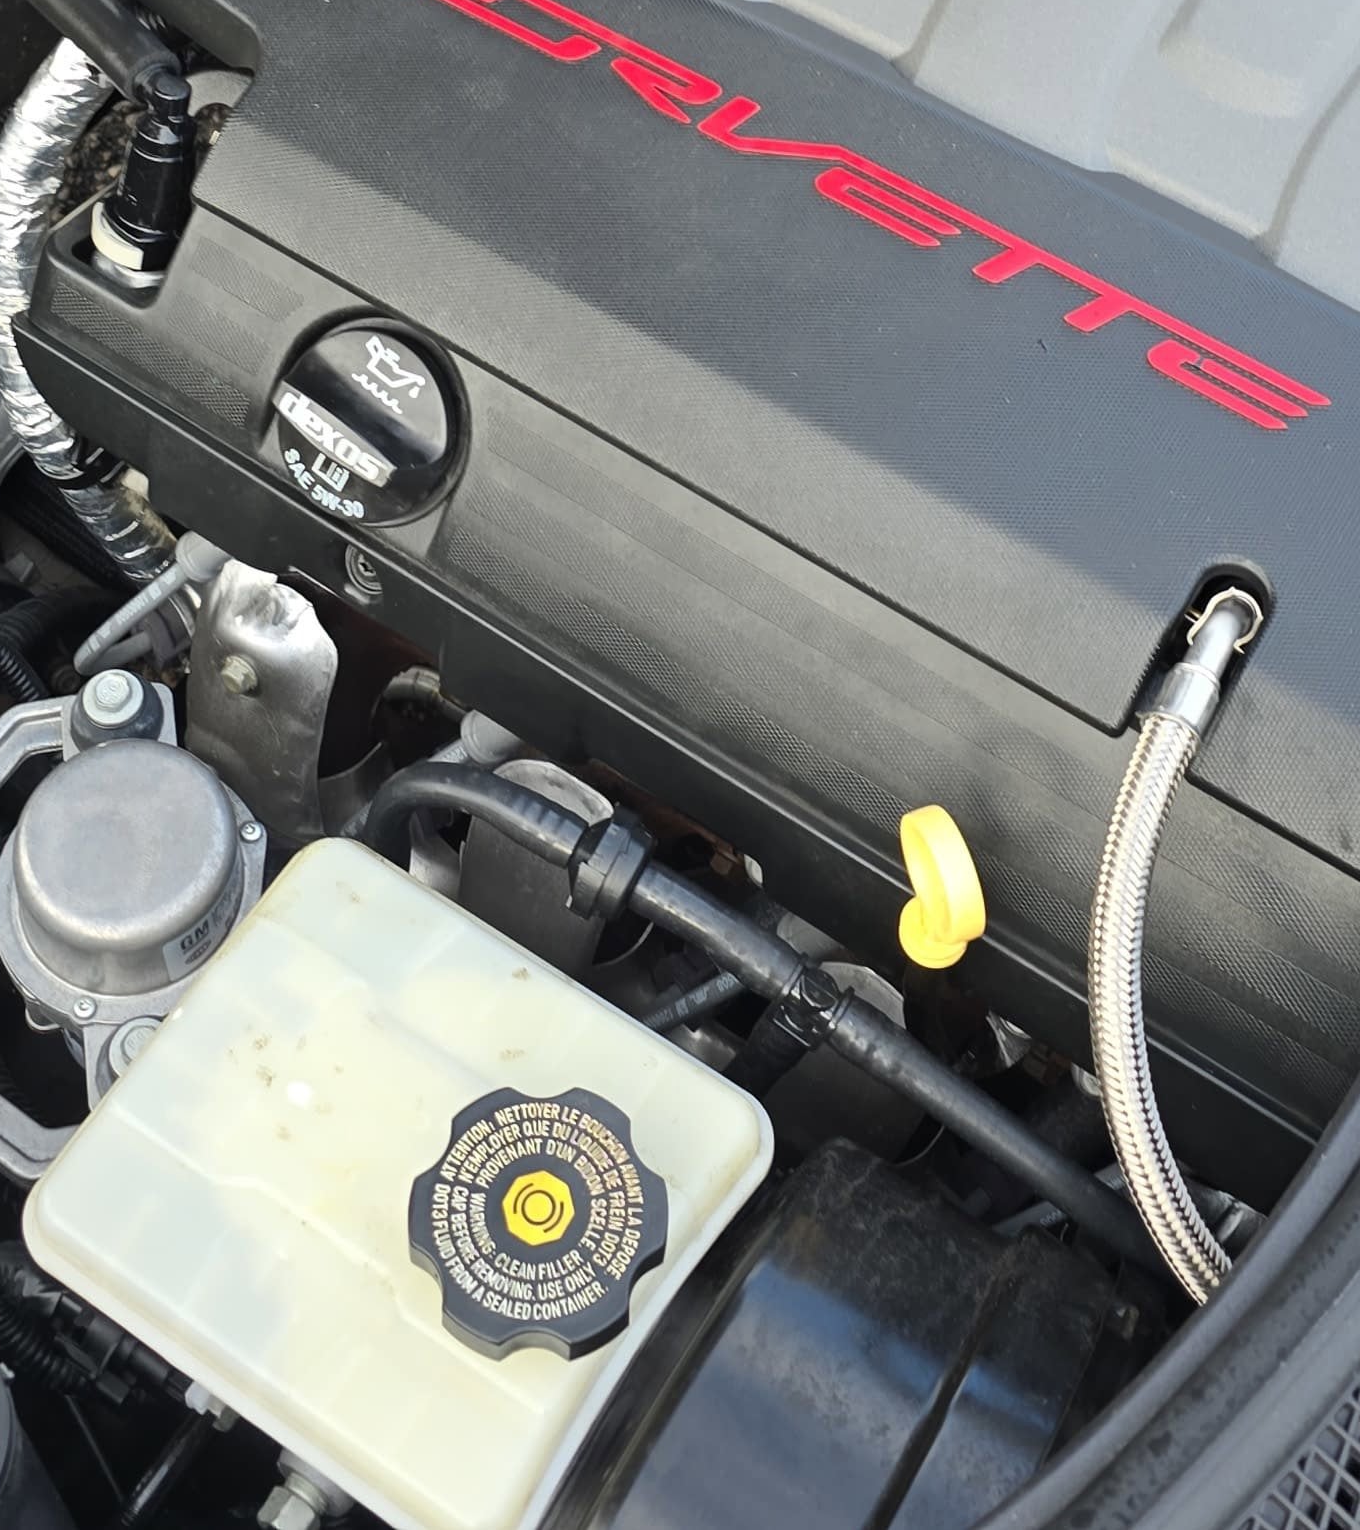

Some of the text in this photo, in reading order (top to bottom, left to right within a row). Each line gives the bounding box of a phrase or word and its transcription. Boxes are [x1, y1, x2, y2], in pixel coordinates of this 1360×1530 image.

[278, 391, 380, 481] dexos
[284, 448, 365, 519] SAE 5W-30
[494, 1102, 561, 1127] NETTOYER
[561, 1105, 581, 1125] LE
[475, 1137, 543, 1190] PROVENANT
[545, 1139, 577, 1163] D'UN
[431, 1182, 451, 1220] DOT3
[451, 1185, 470, 1212] CAP
[458, 1120, 626, 1268] N'EMPLOYER QUE DU LIQUIDE DE FREIN DOT3
[619, 1163, 644, 1205] AVANT
[627, 1206, 644, 1226] LA
[432, 1220, 457, 1260] FLUID
[451, 1212, 480, 1265] BEFORE
[444, 1255, 479, 1295] FROM
[494, 1252, 537, 1281] CLEAN
[538, 1248, 585, 1280] FILLER
[564, 1260, 597, 1292] ONLY
[471, 1284, 486, 1303] A
[482, 1290, 532, 1321] SEALED
[537, 1278, 565, 1301] USE
